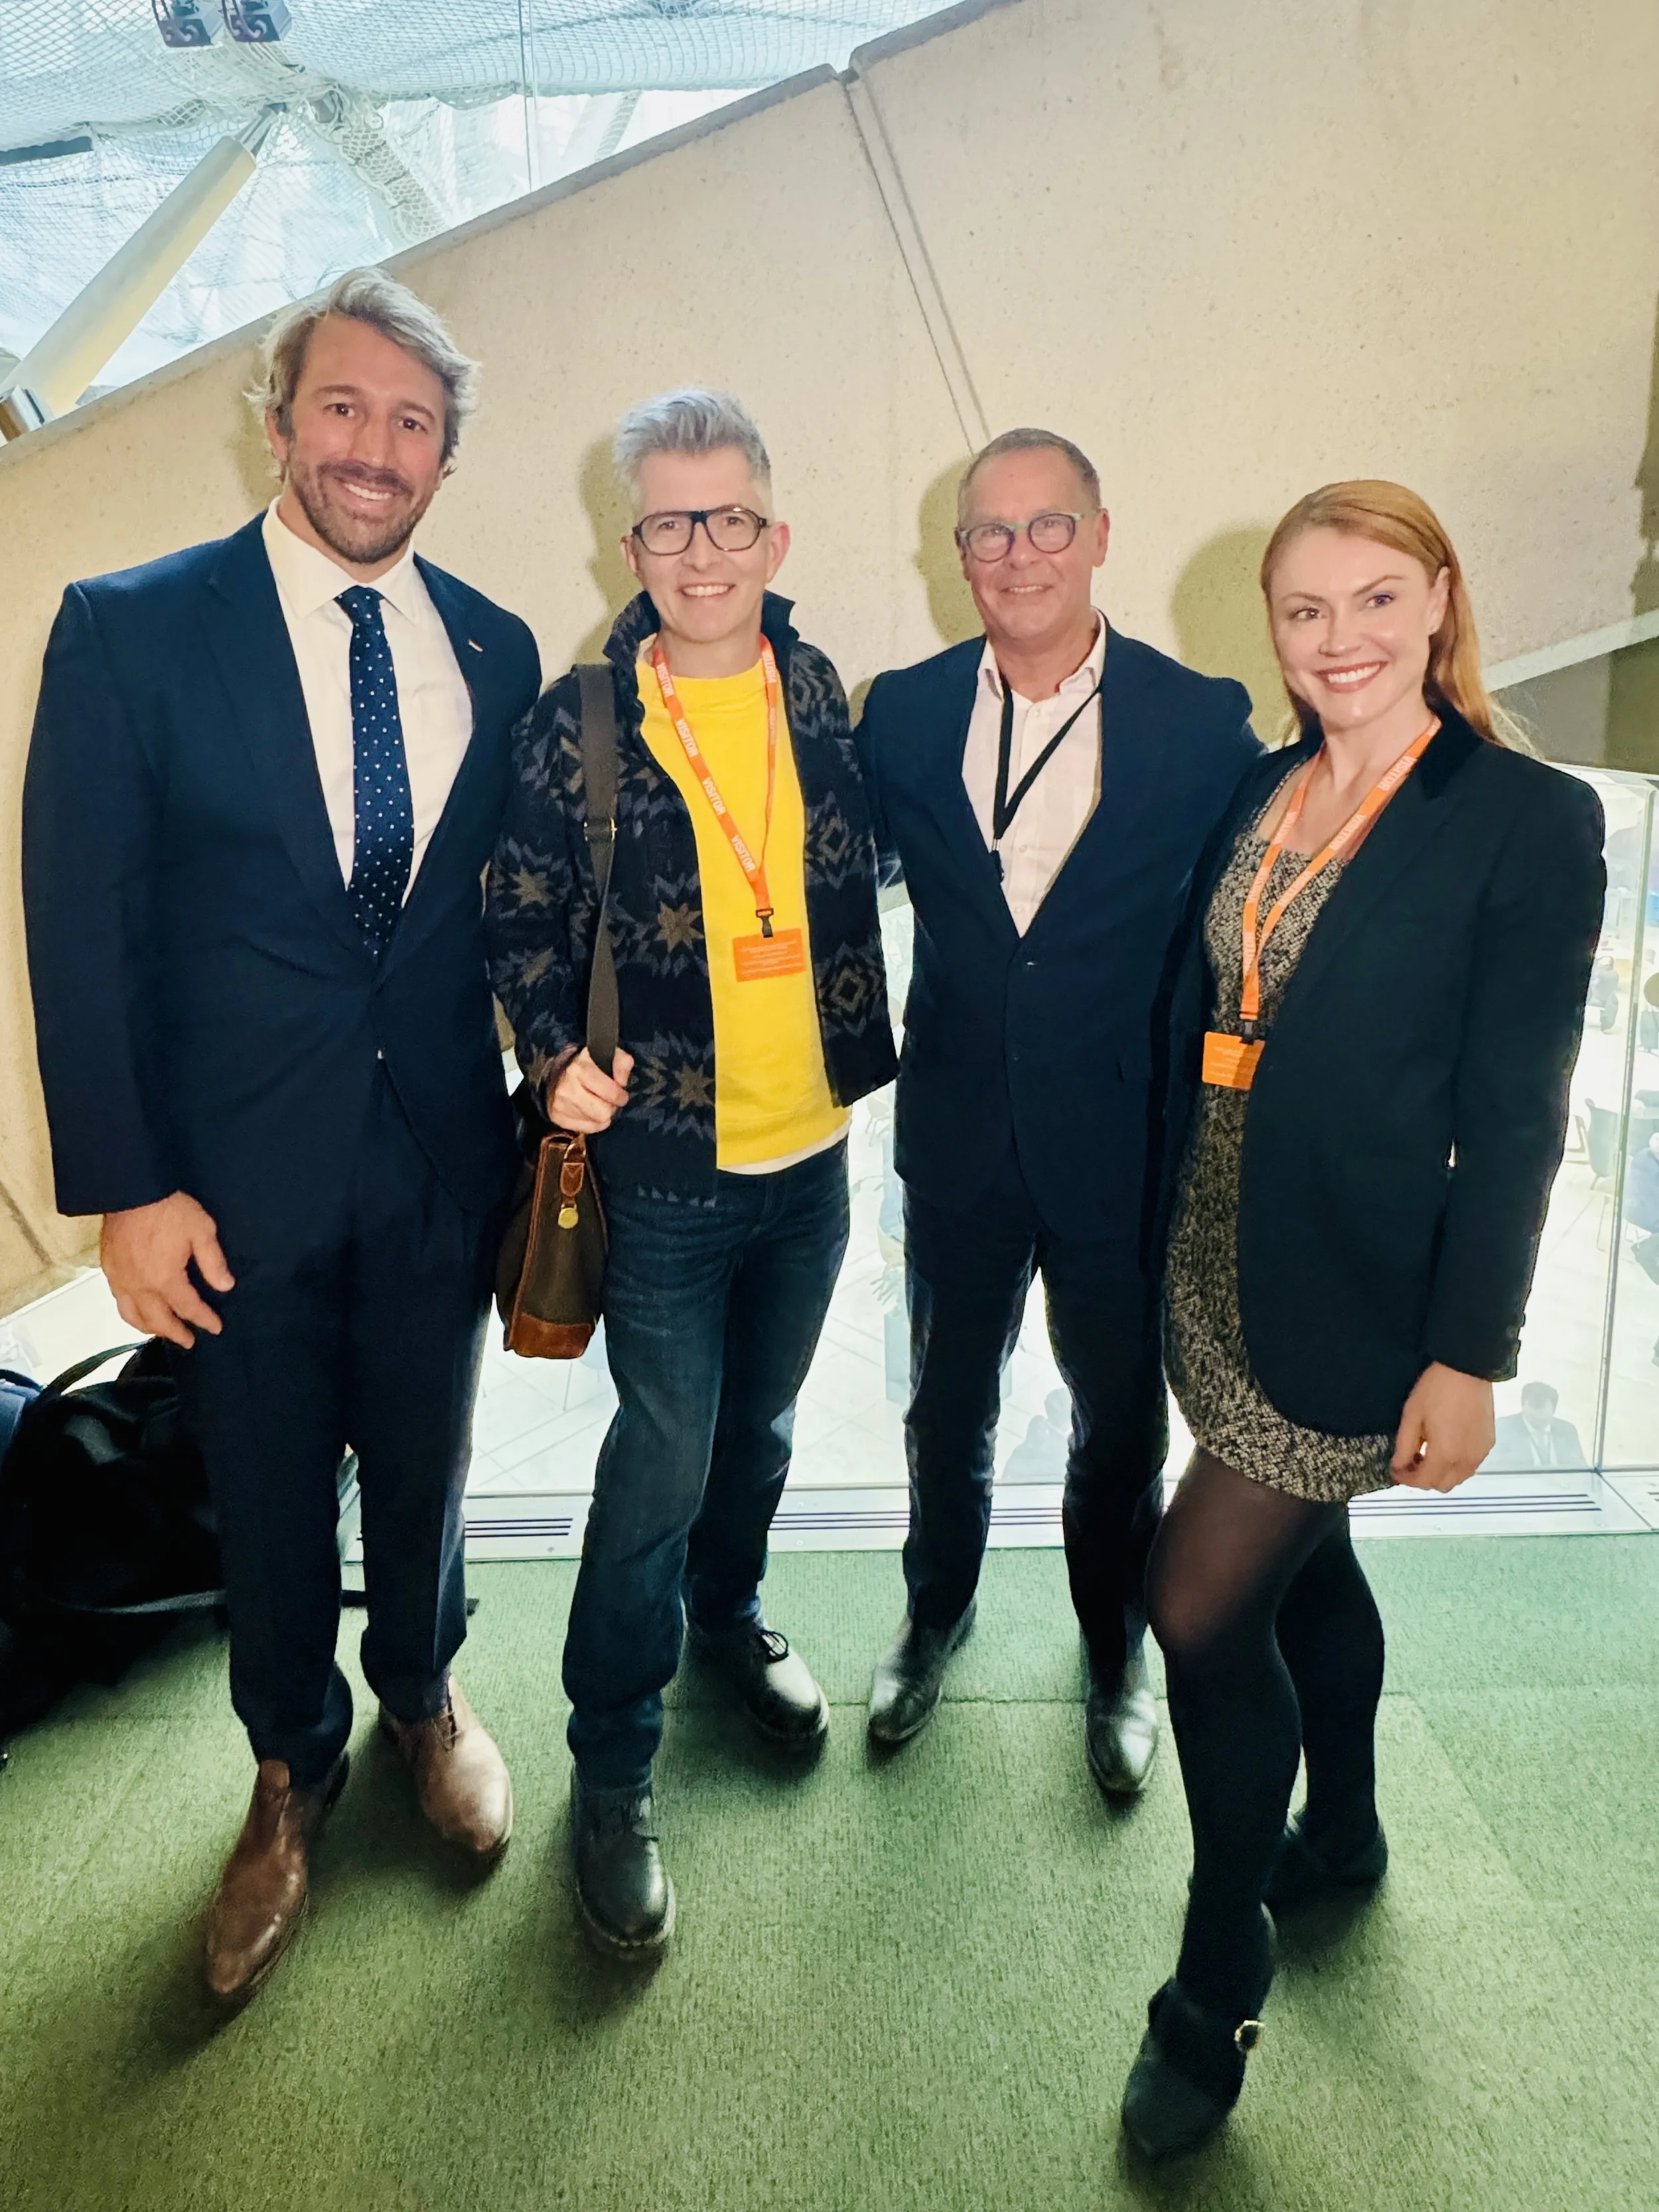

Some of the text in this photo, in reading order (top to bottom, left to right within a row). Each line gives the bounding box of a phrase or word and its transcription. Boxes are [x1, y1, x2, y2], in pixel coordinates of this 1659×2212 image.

[656, 662, 675, 698] VISITOR
[676, 717, 699, 757] VISITOR
[1376, 755, 1417, 791] VISITOR
[702, 776, 726, 816] VISITOR
[731, 834, 757, 873] VISITOR
